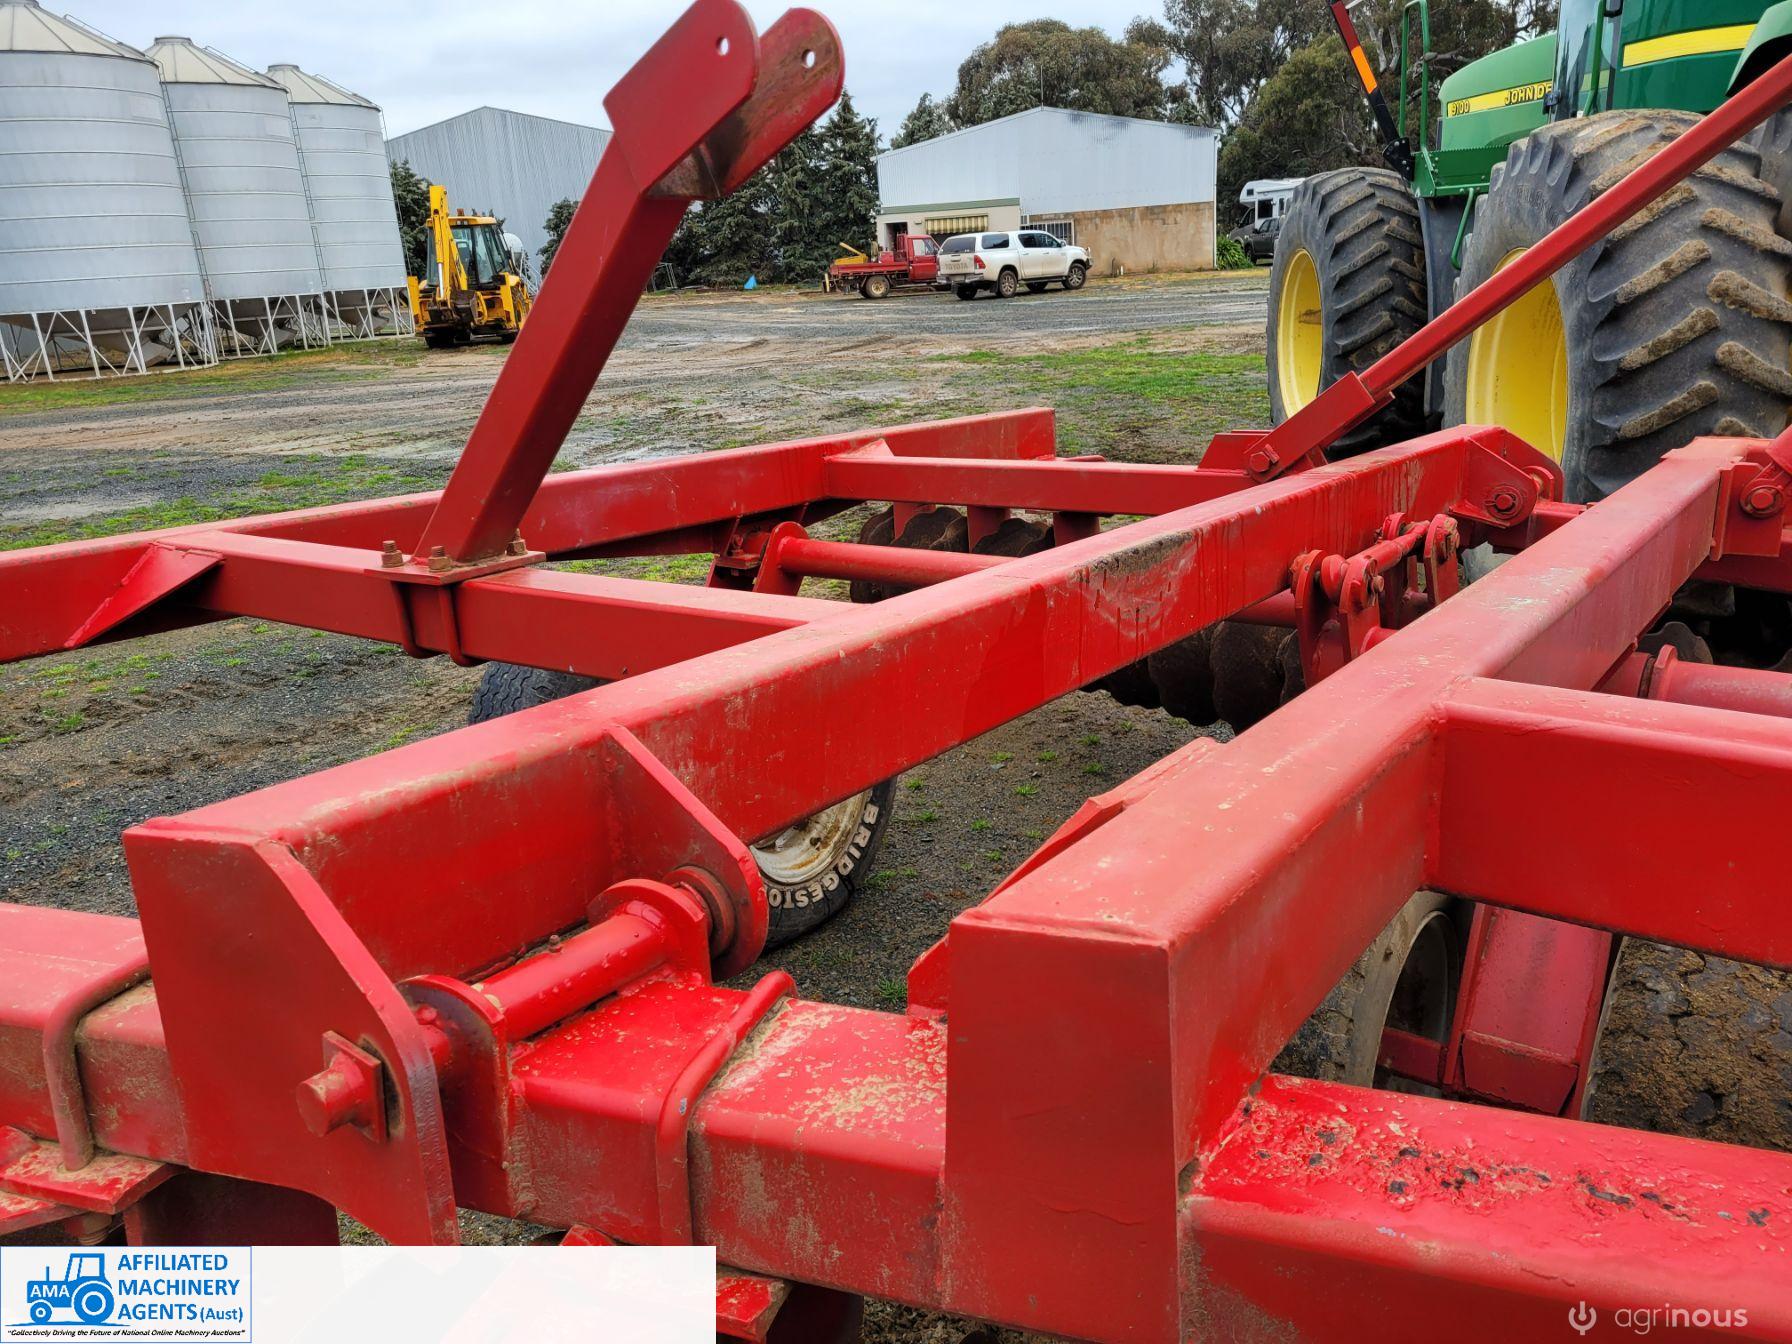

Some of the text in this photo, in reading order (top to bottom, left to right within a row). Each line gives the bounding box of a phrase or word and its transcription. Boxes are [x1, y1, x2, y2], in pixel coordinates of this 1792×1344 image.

[1504, 86, 1535, 106] JOHN
[1451, 100, 1471, 116] 9100
[944, 262, 969, 271] TOYOTA
[768, 803, 879, 909] BRIDGESTO
